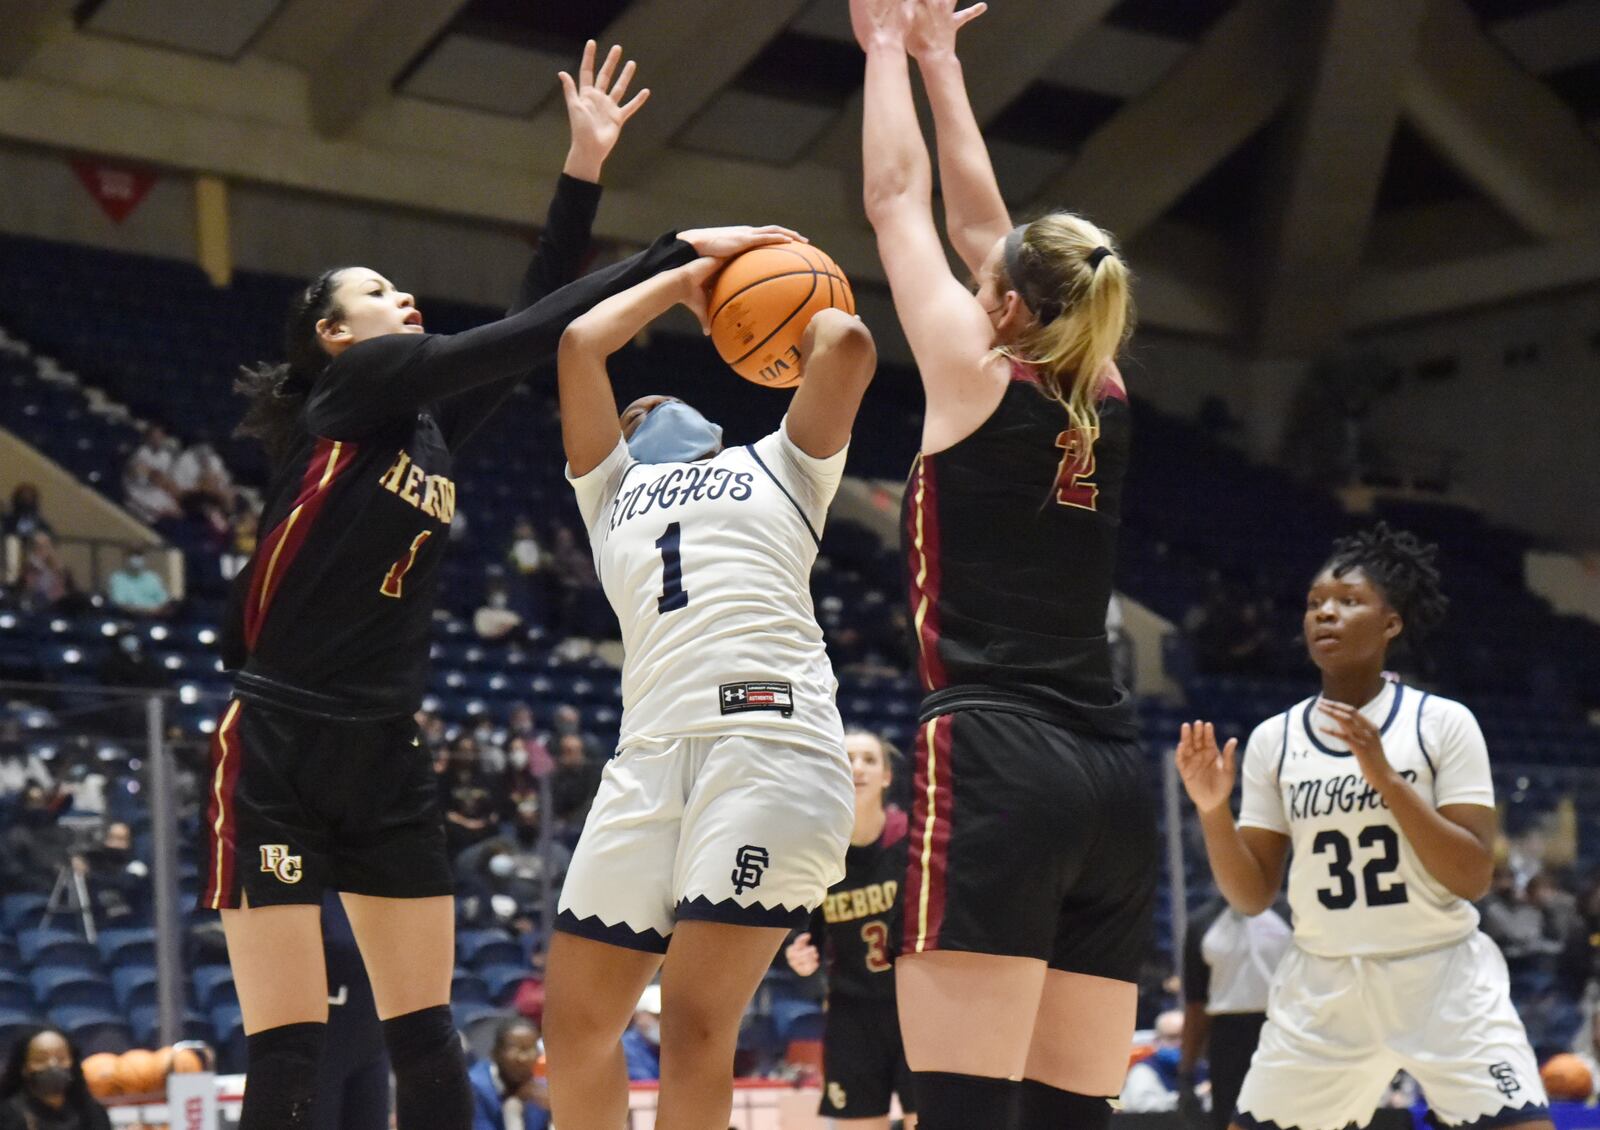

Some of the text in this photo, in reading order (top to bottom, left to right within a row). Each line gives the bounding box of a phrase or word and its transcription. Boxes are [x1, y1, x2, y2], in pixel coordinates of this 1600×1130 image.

[1055, 426, 1100, 512] 2
[379, 530, 433, 599] 1
[655, 521, 689, 615] 1
[1289, 769, 1418, 821] KNIGH
[731, 844, 769, 896] SF
[1312, 824, 1409, 911] 32
[861, 920, 892, 973] 3
